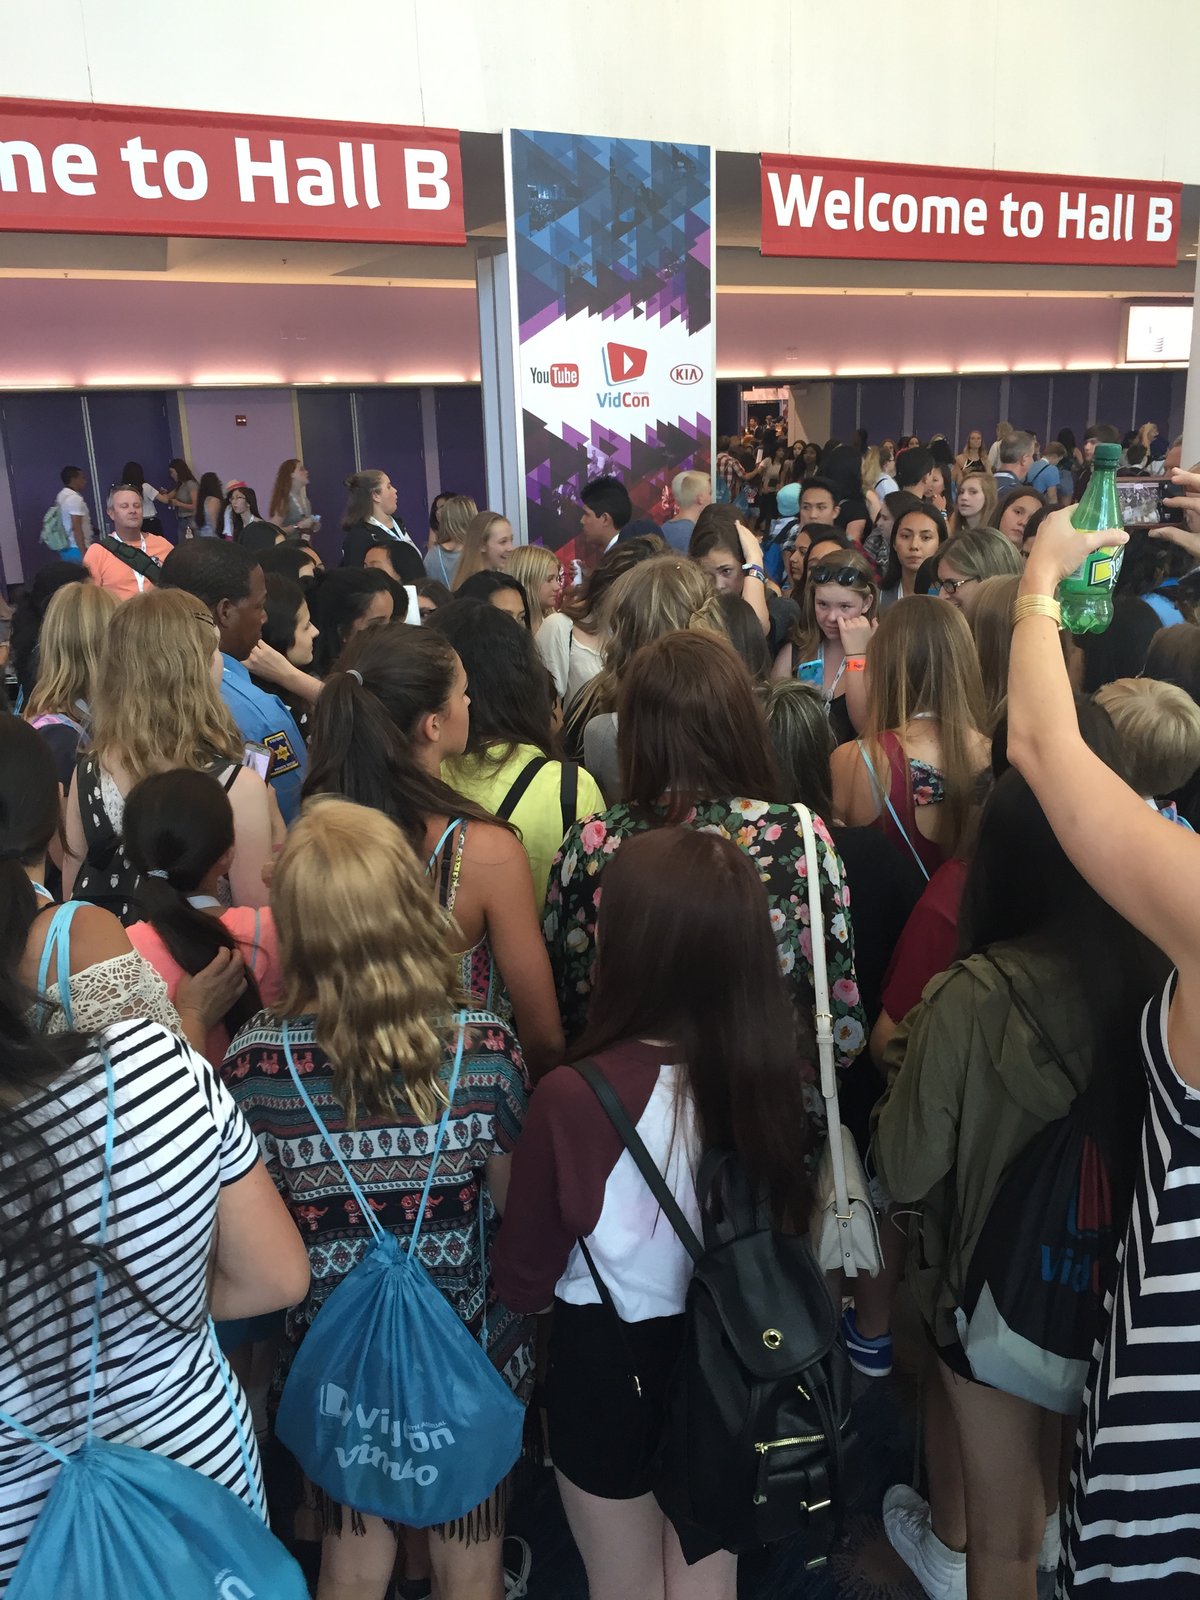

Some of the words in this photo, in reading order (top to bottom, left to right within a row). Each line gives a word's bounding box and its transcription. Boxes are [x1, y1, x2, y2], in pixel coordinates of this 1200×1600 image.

[120, 136, 208, 200] to
[234, 137, 381, 209] Hall
[404, 149, 451, 211] B
[767, 173, 987, 236] Welcome
[1000, 192, 1044, 238] to
[1057, 192, 1134, 241] Hall
[1146, 197, 1173, 242] B
[530, 366, 578, 384] YouTube
[676, 369, 698, 380] KIA
[596, 391, 650, 408] VidCon
